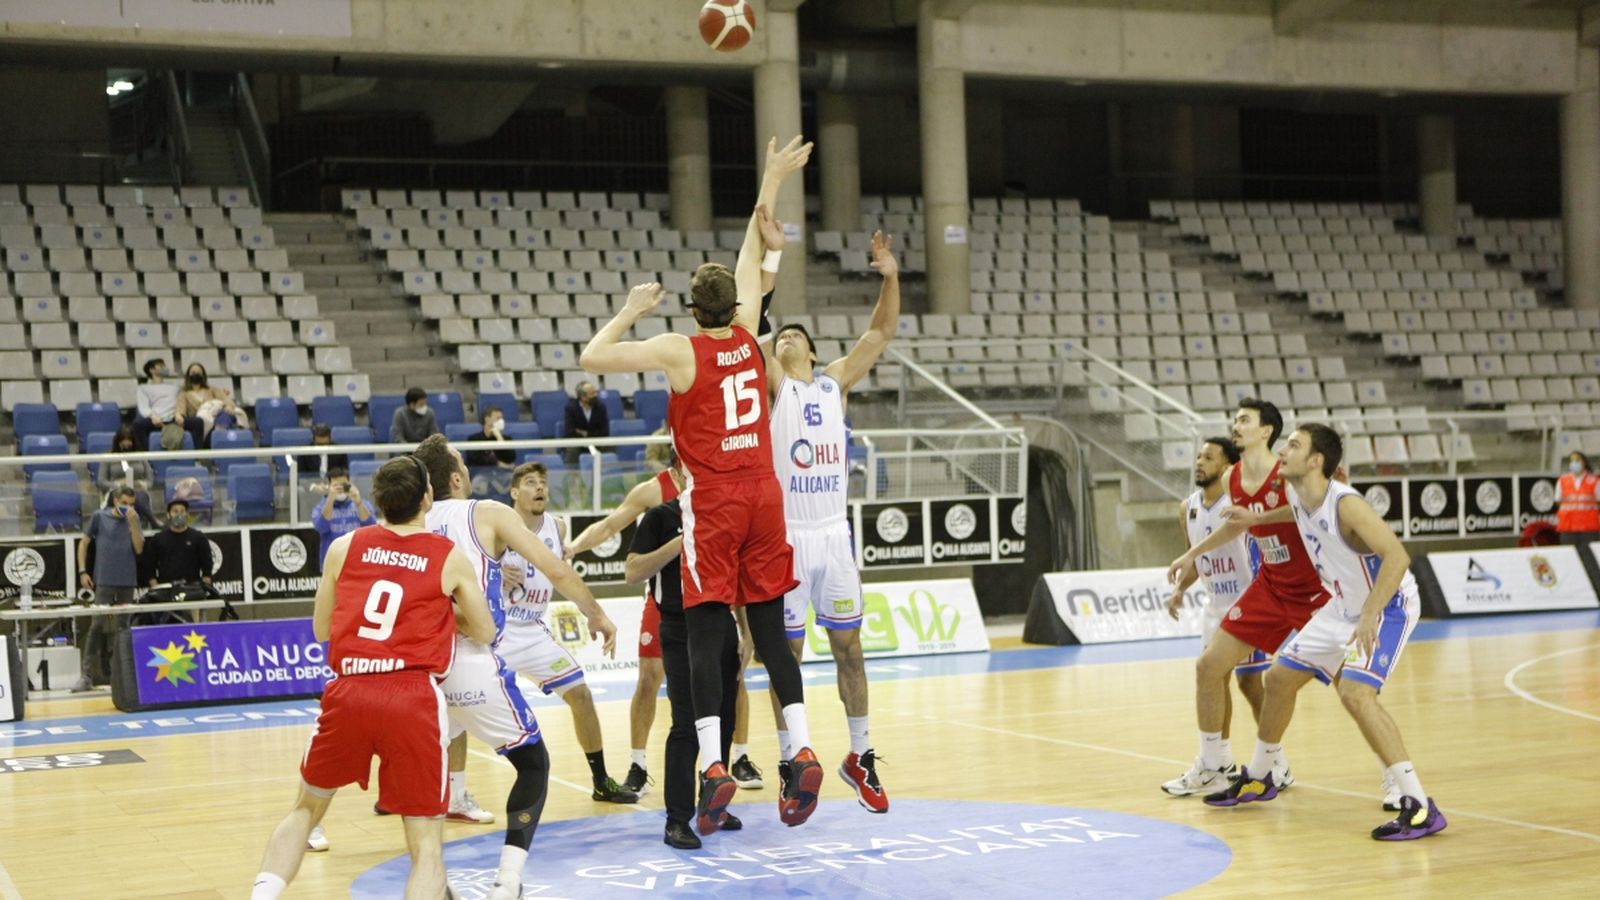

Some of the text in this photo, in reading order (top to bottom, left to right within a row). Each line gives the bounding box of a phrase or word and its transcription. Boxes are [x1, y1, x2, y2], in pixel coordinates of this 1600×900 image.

[719, 368, 761, 431] 15
[803, 402, 823, 426] 45
[721, 433, 759, 452] GIRONA
[790, 475, 840, 493] ALICANTE
[361, 546, 429, 573] JÓNSSON
[357, 579, 404, 641] 9
[205, 642, 324, 671] LA NUC
[601, 661, 638, 671] ALICAN
[207, 662, 337, 685] CIUDAD DEL DEPO
[575, 815, 1094, 879] GENERALITAT
[603, 828, 1142, 890] VALENCIANA
